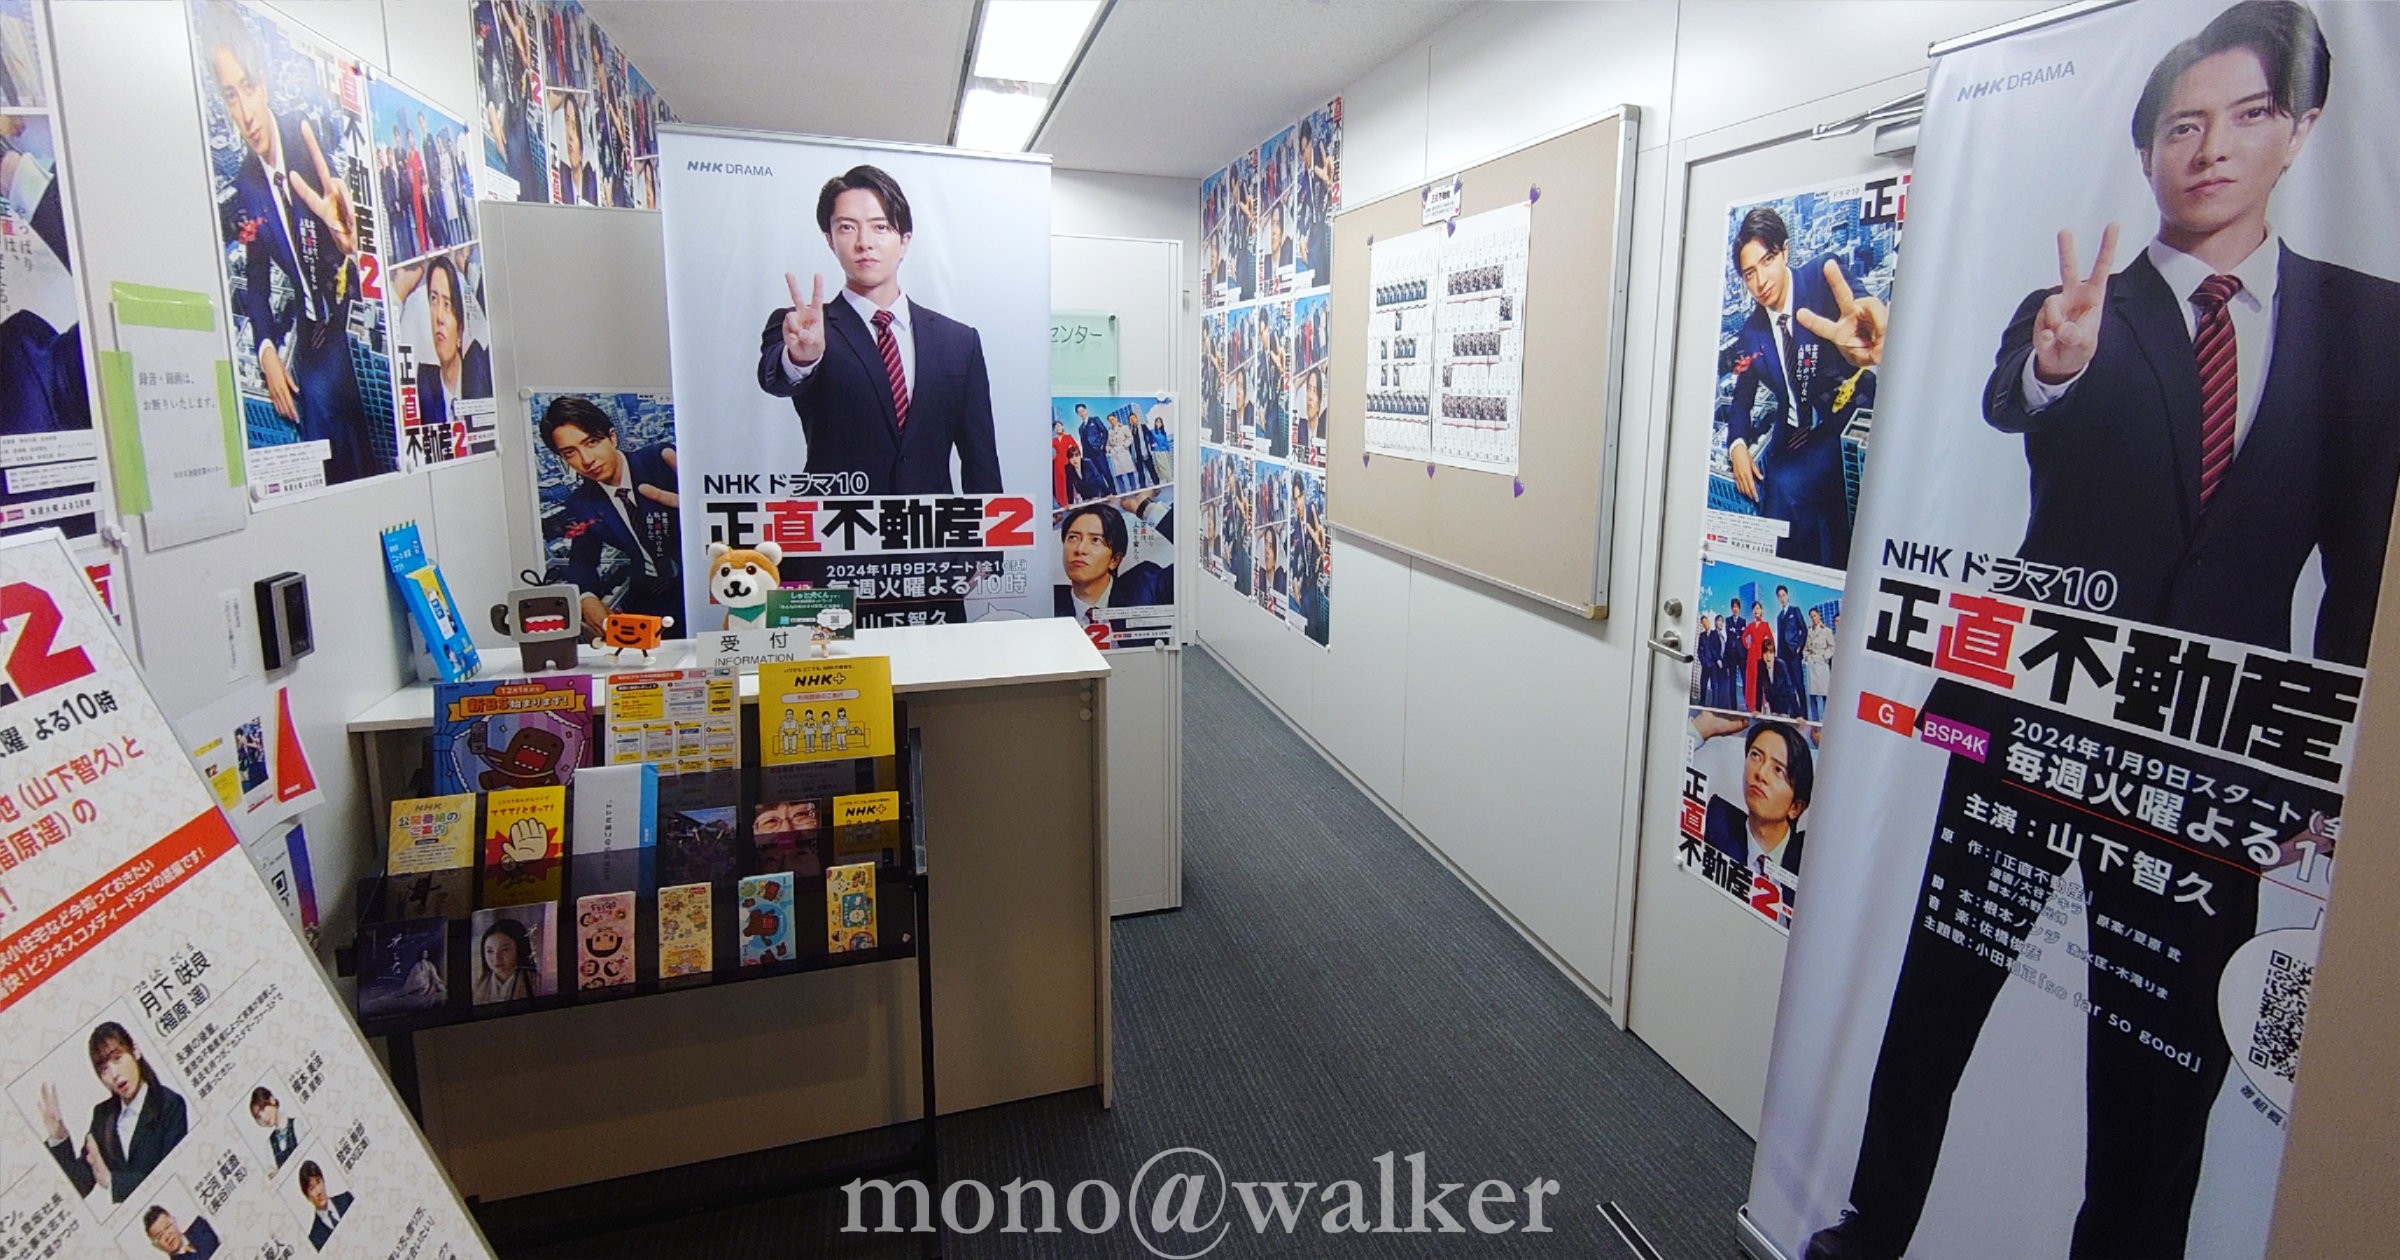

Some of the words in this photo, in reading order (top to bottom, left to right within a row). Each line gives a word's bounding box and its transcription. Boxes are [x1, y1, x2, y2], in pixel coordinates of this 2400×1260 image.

[1957, 78, 2004, 102] NHK
[2006, 60, 2075, 91] DRAMA
[687, 160, 724, 173] NHK
[725, 163, 773, 177] DRAMA
[704, 474, 762, 495] NHK
[770, 471, 869, 495] ドラマ10
[706, 497, 1034, 553] 正直不動産2
[1882, 537, 1953, 580] NHK
[1961, 549, 2119, 612] ドラマ10
[862, 610, 948, 630] 山下智久
[714, 652, 794, 668] INFORMATION
[1866, 576, 2365, 786] 正直不動産
[34, 690, 118, 741] よる10時
[1877, 703, 1896, 726] G
[1923, 720, 1988, 756] BSP4K
[2005, 740, 2330, 884] 毎週火曜よる1
[139, 976, 175, 1018] 月下
